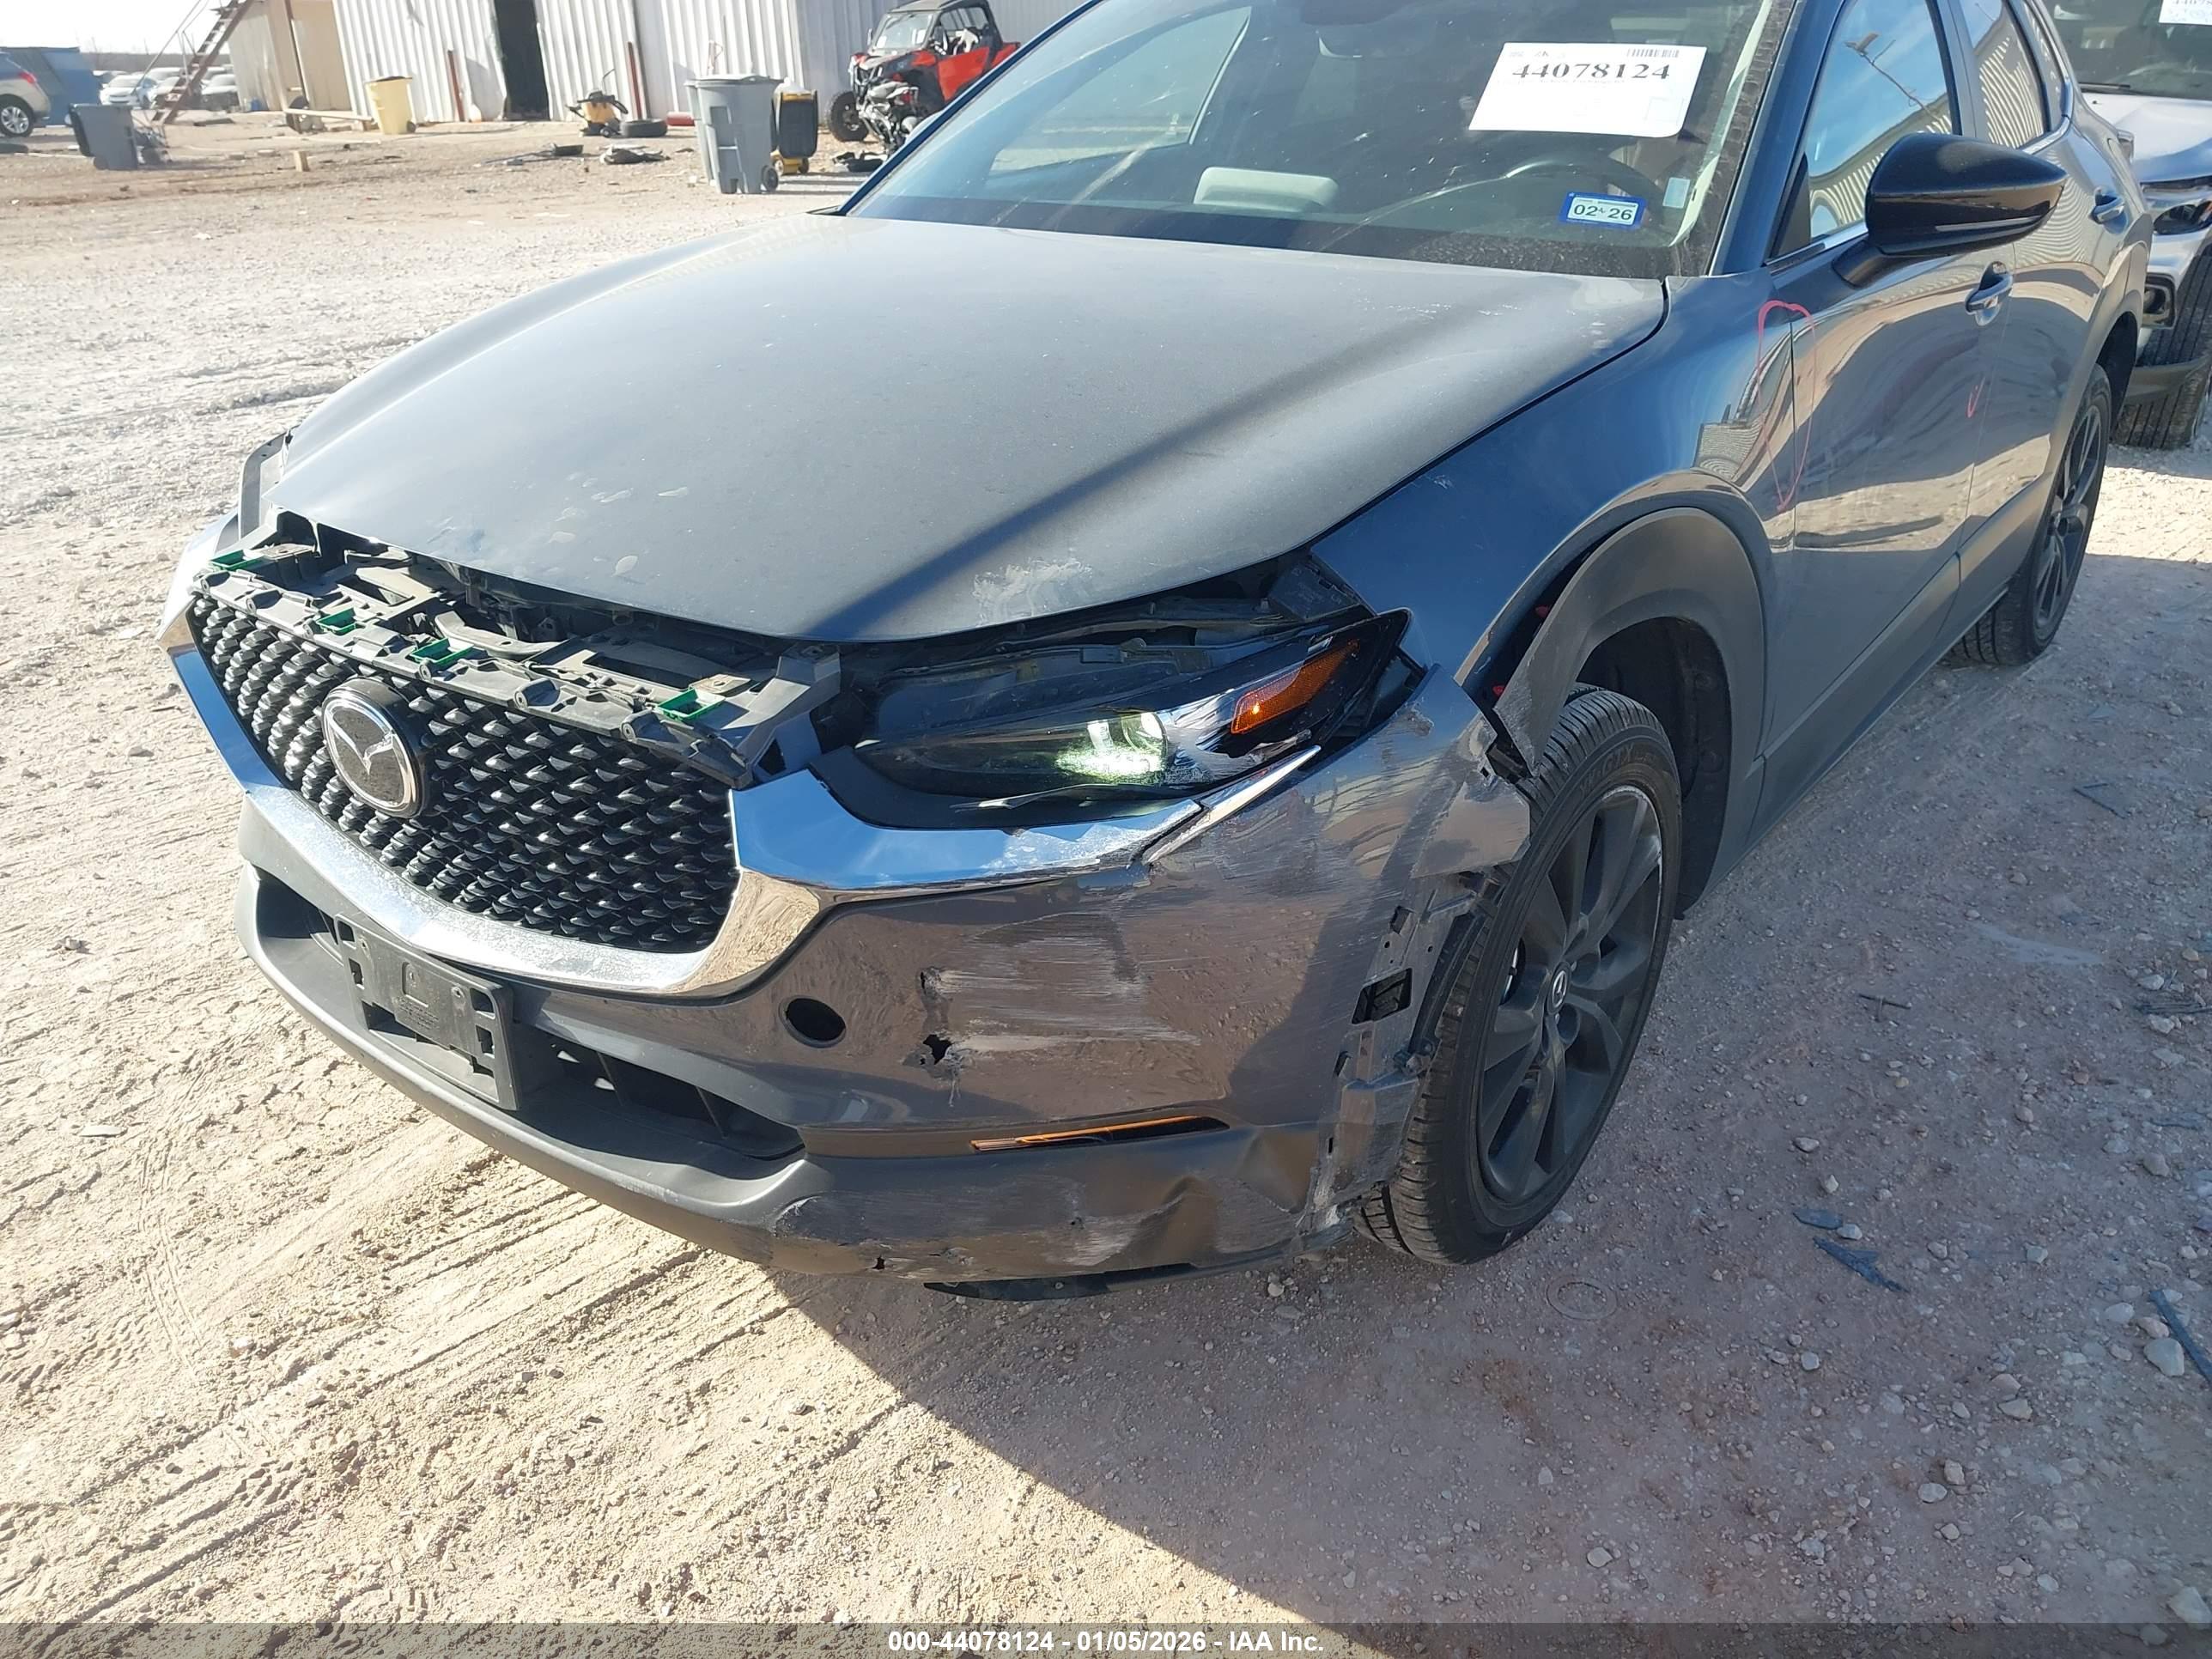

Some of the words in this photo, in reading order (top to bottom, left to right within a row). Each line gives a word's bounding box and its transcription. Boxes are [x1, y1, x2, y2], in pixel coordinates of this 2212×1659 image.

[1512, 64, 1670, 79] 44078124
[1574, 204, 1598, 216] 02
[1607, 208, 1633, 221] 26
